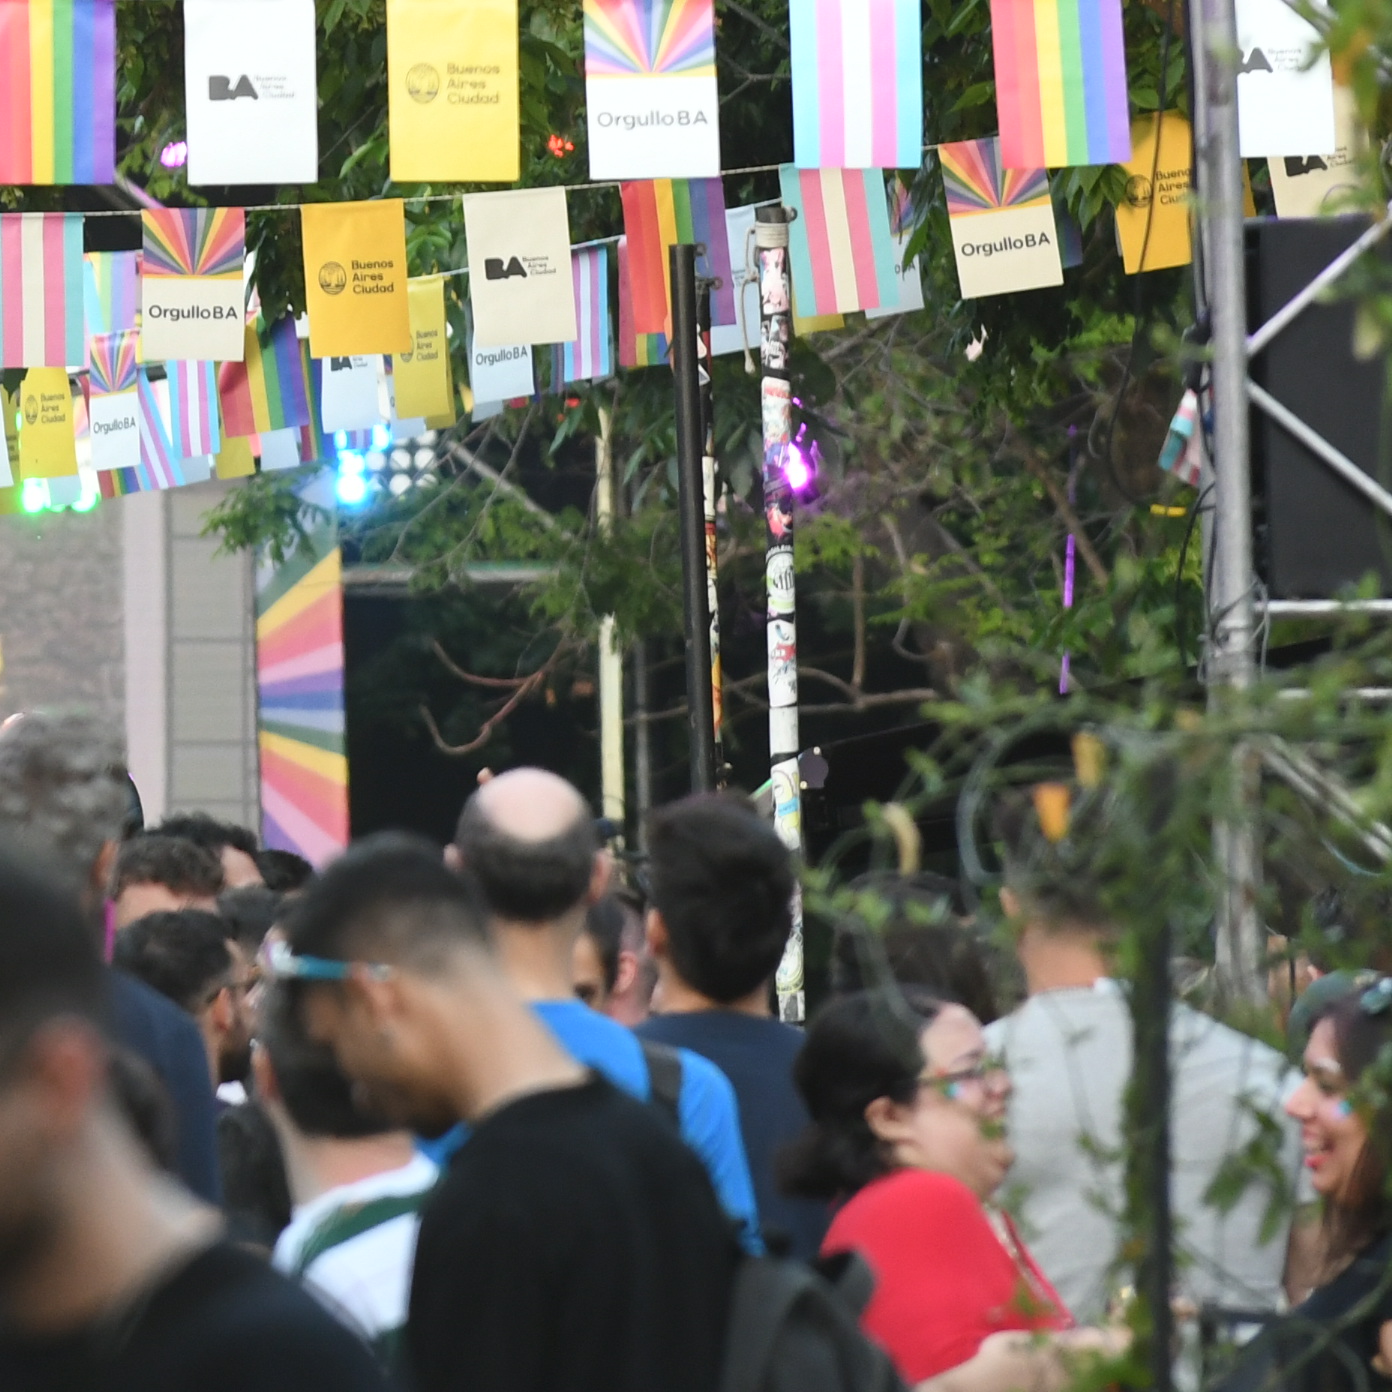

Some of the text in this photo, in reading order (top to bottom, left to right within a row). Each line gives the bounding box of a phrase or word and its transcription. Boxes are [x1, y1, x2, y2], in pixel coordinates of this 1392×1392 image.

[446, 62, 501, 75] Buenos
[208, 74, 258, 101] BA
[446, 77, 486, 90] Aires
[446, 91, 500, 105] Ciudad
[597, 110, 709, 130] OrgulloBA
[960, 231, 1051, 258] OrgulloBA
[351, 259, 394, 270] Buenos
[485, 255, 527, 280] BA
[352, 273, 384, 282] Aires
[352, 283, 395, 294] Ciudad
[148, 304, 238, 322] OrgulloBA
[476, 347, 528, 366] OrgulloBA
[93, 418, 136, 435] OrgulloBA
